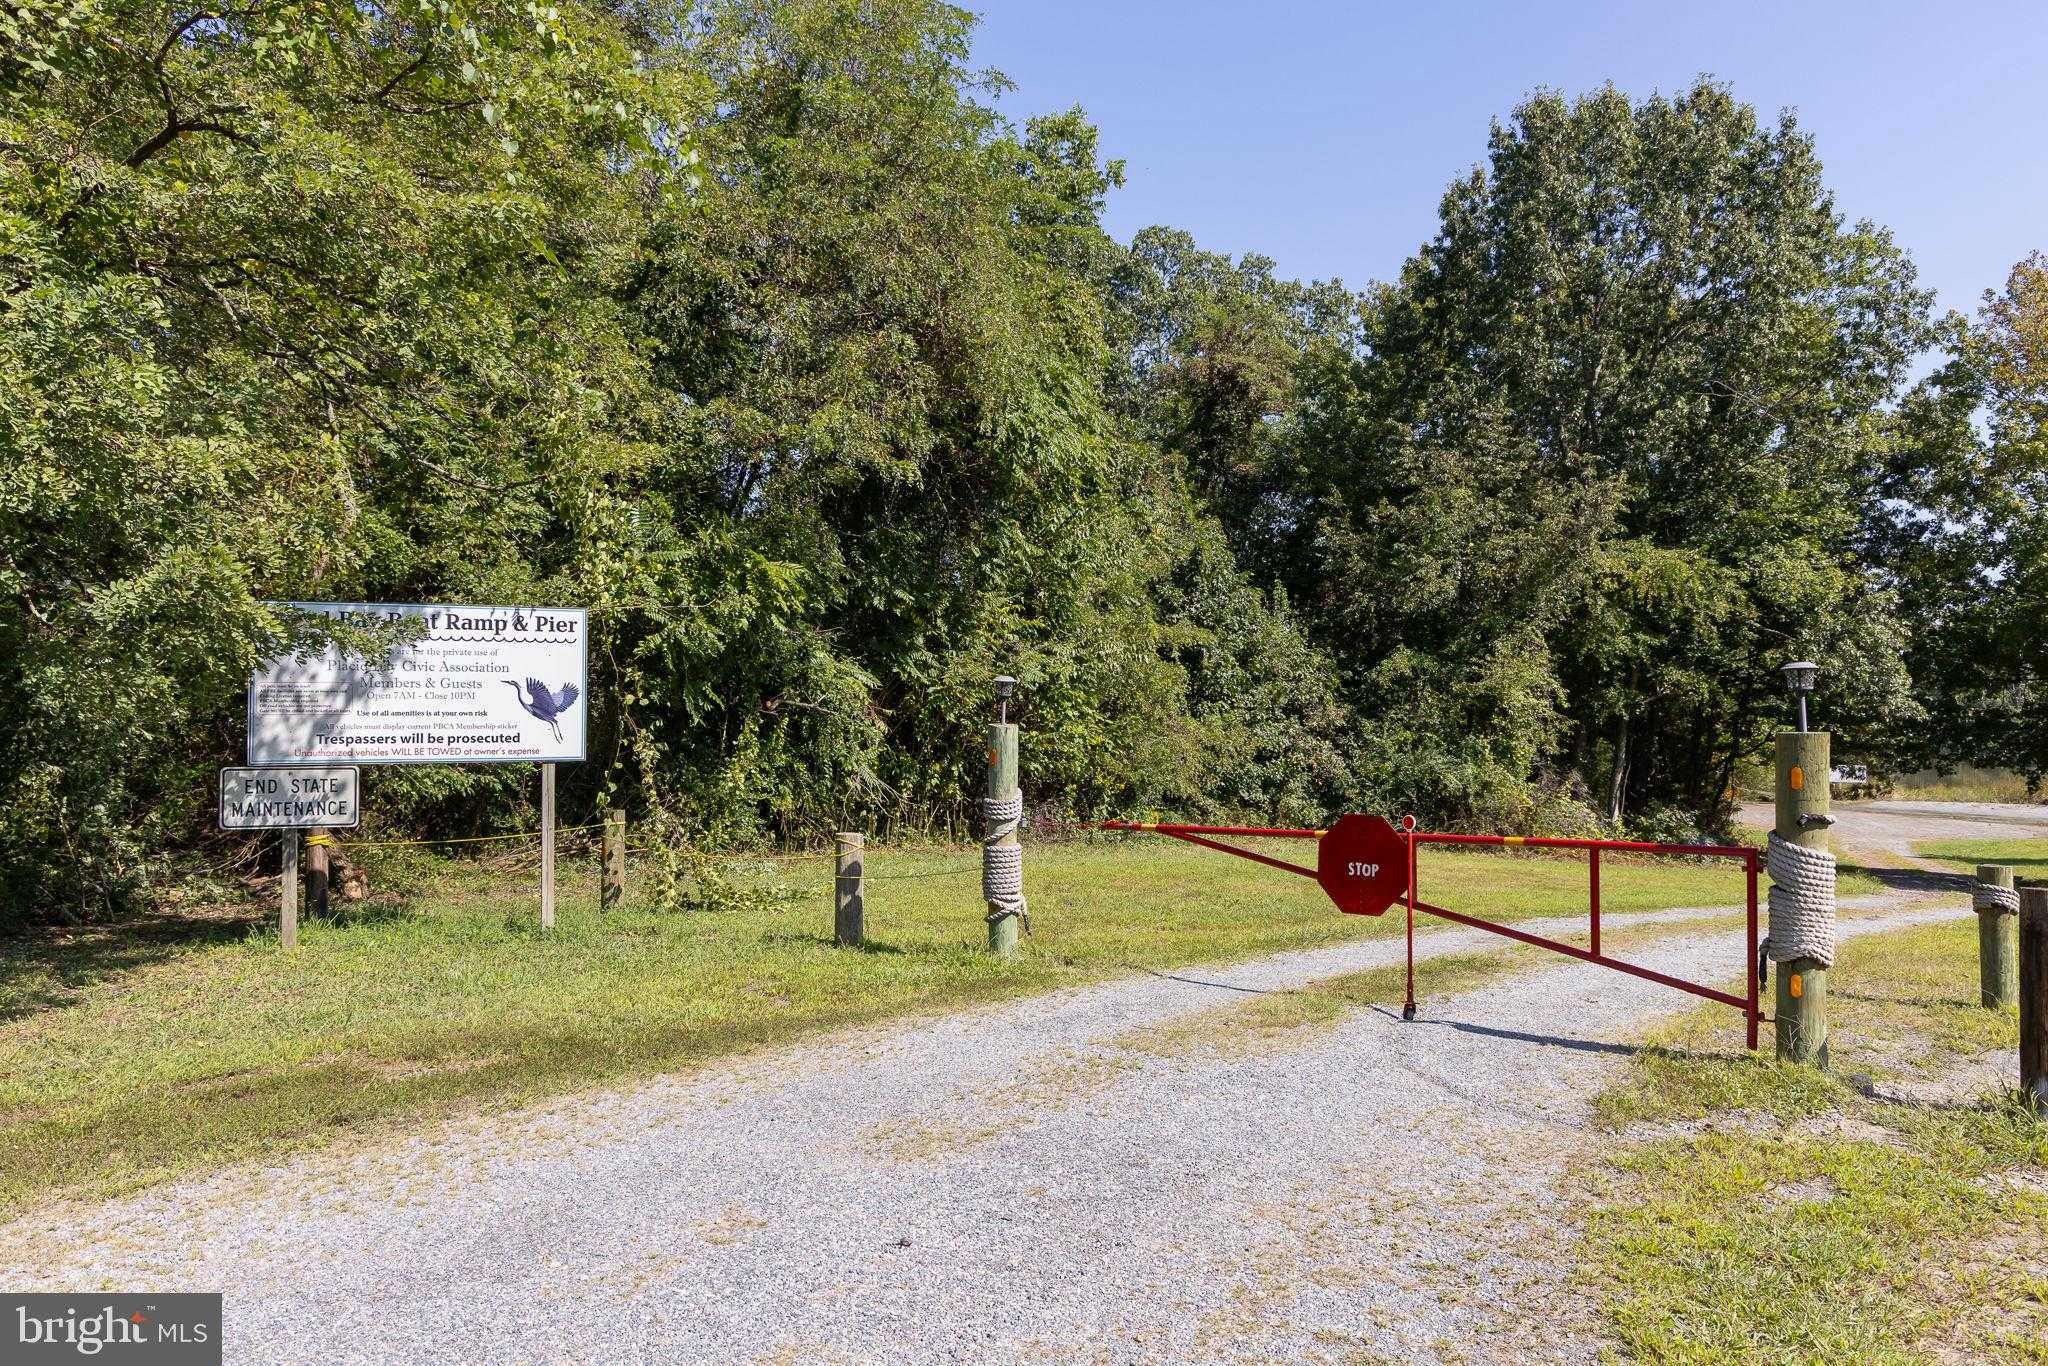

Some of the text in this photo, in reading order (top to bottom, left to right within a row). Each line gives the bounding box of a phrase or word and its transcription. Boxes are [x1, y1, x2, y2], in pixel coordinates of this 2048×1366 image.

[446, 613, 507, 635] Ramp
[513, 615, 529, 632] &
[535, 616, 578, 633] Pier
[427, 647, 440, 656] the
[443, 648, 472, 658] private
[490, 647, 499, 656] of
[402, 660, 436, 672] Civic
[438, 661, 510, 673] Association
[360, 676, 483, 689] Members & Guests
[366, 691, 391, 702] Open
[393, 691, 415, 700] 7AM
[424, 691, 448, 700] Close
[450, 691, 476, 700] 10PM
[356, 709, 369, 717] Use
[371, 709, 380, 717] of
[380, 709, 389, 717] all
[390, 709, 425, 717] amenities
[426, 709, 432, 717] is
[433, 709, 441, 717] at
[442, 711, 457, 719] your
[475, 709, 488, 717] risk
[383, 722, 406, 732] display
[433, 722, 454, 730] PBCA
[316, 733, 521, 747] Trespassers will be prosecuted
[294, 747, 540, 758] Unauthorized vehicles WILL BE TOWED at owner's expense
[244, 778, 338, 794] END STATE
[231, 800, 347, 817] MAINTENANCE
[1348, 862, 1379, 877] STOP
